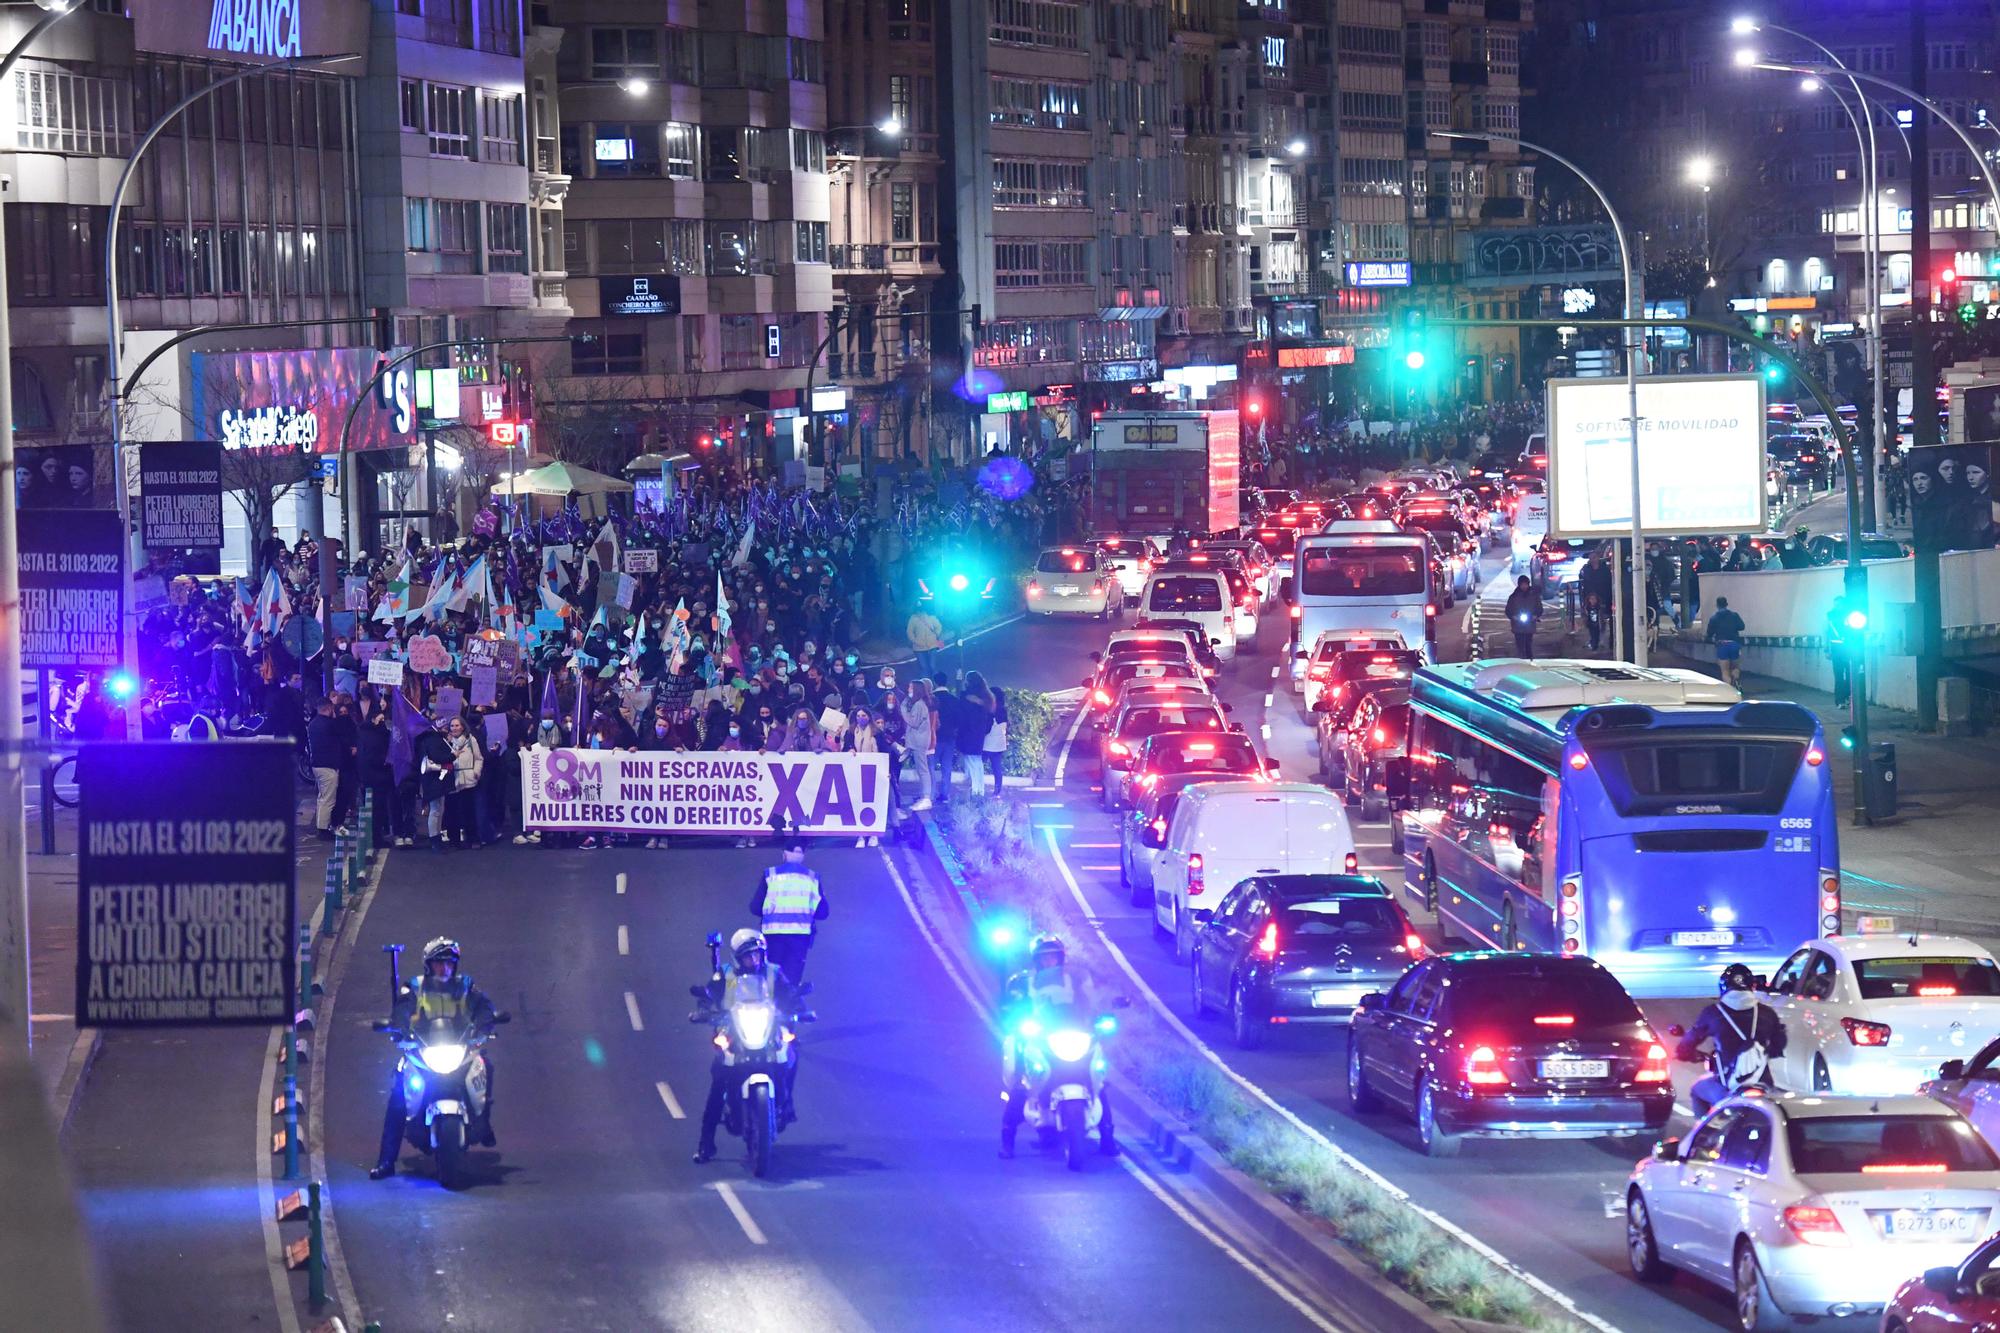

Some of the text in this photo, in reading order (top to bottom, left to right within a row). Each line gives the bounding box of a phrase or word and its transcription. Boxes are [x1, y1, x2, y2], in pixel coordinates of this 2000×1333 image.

[208, 0, 302, 58] ABANCA
[626, 294, 658, 302] CAAMAÑO
[1657, 417, 1739, 431] MOVILIDAD
[144, 472, 169, 485] HASTA
[169, 472, 178, 484] EL
[145, 495, 219, 510] PETER LINDBERGH
[145, 509, 220, 524] UNTOLD STORIES
[146, 525, 153, 539] A
[188, 524, 220, 538] GALICIA
[18, 552, 118, 573] ASTA EL 31.03.2022
[19, 588, 118, 612] ETER LINDBERGH
[20, 610, 118, 633] NTOLD STORIES
[70, 633, 118, 654] GALICIA
[620, 761, 763, 782] NIN ESCRAVAS,
[620, 784, 654, 802] NIN
[766, 763, 877, 827] XA!
[529, 803, 764, 826] MULLERES CON DEREITOS
[1780, 818, 1812, 829] 6565
[88, 820, 286, 856] HASTA EL 31.03.2022
[88, 883, 287, 924] PETER LINDBERGH
[88, 922, 286, 961] UNTOLD STORIES
[88, 963, 104, 999] A
[199, 961, 284, 998] GALICIA
[1897, 1216, 1967, 1233] 6273 GKC
